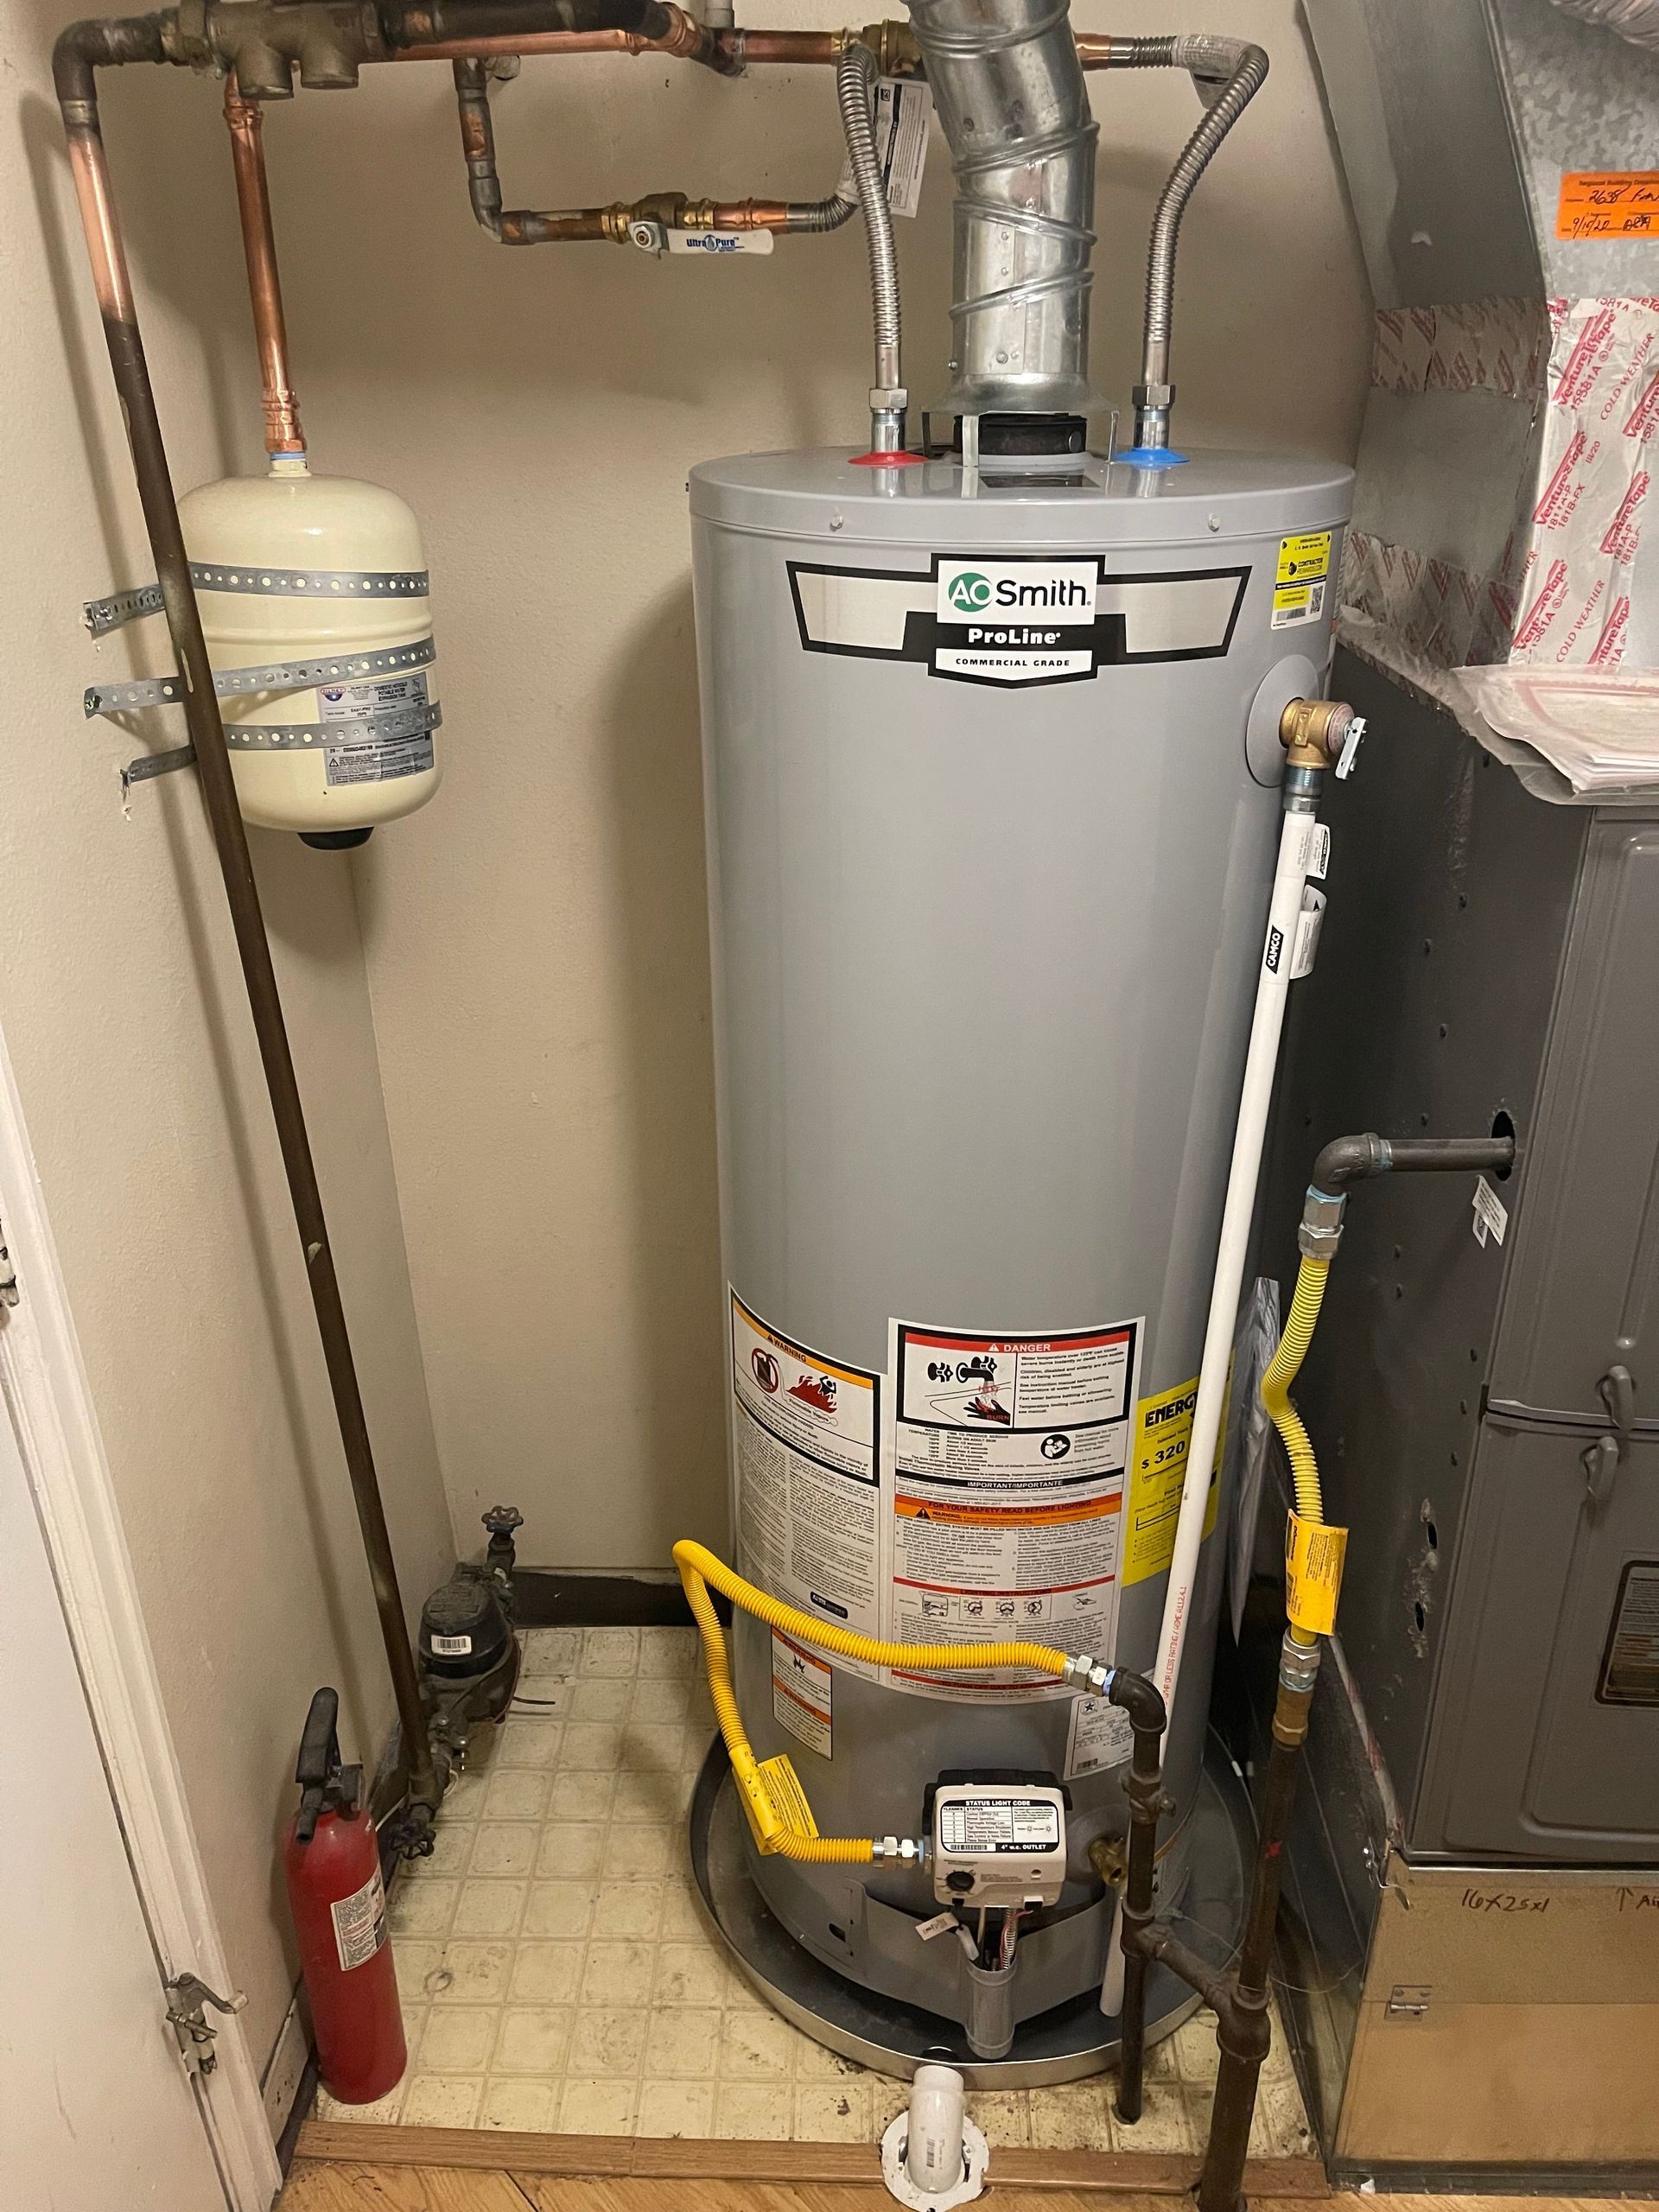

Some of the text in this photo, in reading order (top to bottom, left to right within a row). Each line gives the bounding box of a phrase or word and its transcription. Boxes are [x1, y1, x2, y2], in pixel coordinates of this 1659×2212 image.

[686, 238, 706, 247] Ultra
[1600, 388, 1621, 420] COLD
[1620, 333, 1655, 385] WEATHER
[1559, 482, 1586, 528] 181B-FX
[950, 579, 1086, 607] AO Smith
[1556, 580, 1605, 663] COLD WEATHER
[968, 628, 1057, 645] ProLine
[1267, 932, 1281, 967] CAMCO
[774, 1338, 807, 1363] WARNING
[1003, 1344, 1051, 1352] DANGER
[1145, 1391, 1198, 1428] ENERG
[1141, 1440, 1185, 1470] $ 320
[967, 1480, 1064, 1489] IMPORTANT/IMPORTANTE
[1057, 1500, 1091, 1510] LIGHTING
[1166, 1657, 1175, 1675] LESS
